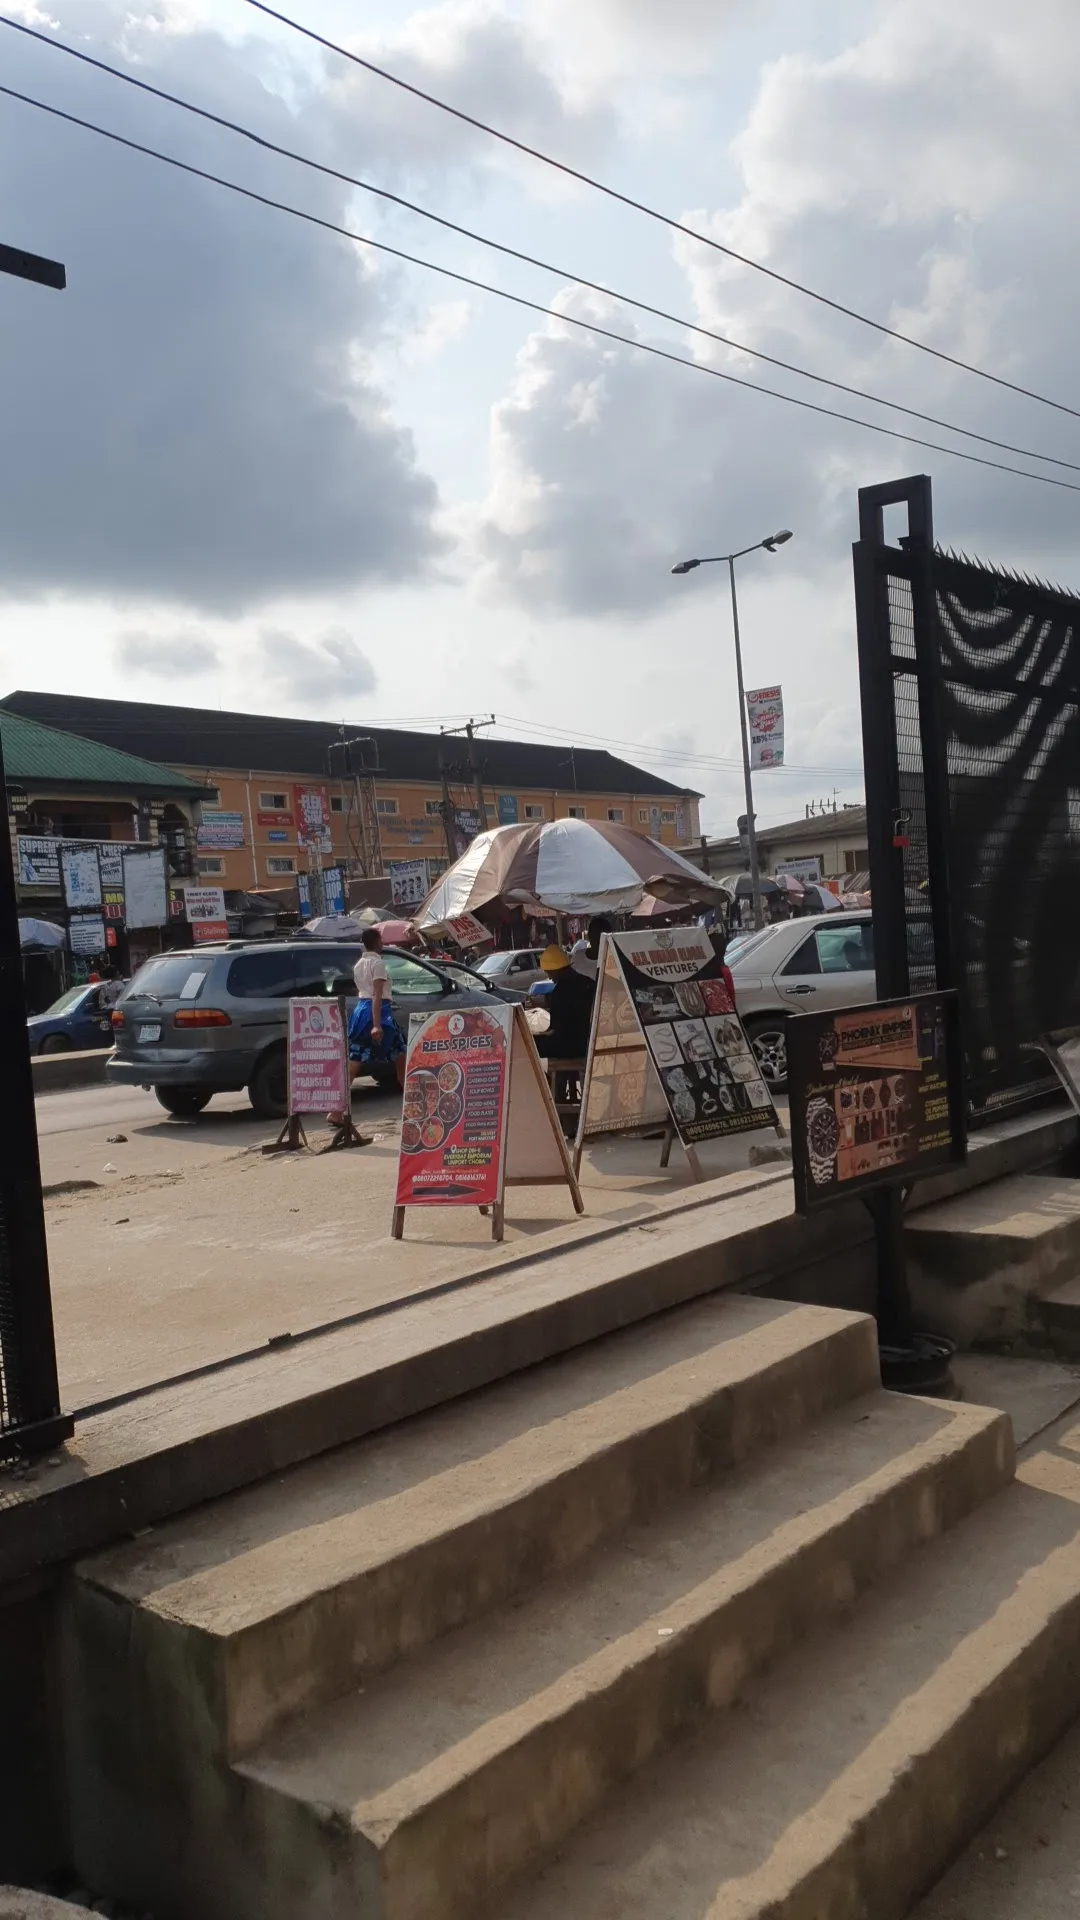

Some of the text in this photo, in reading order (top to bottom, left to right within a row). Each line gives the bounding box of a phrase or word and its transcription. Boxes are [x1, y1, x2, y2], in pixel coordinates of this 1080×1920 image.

[752, 734, 768, 744] 15%
[450, 915, 476, 933] POS
[456, 926, 483, 940] AVAILABLE
[467, 933, 483, 942] HERE
[646, 962, 699, 976] VENTURES
[841, 1024, 882, 1042] PHOENIX
[302, 1038, 334, 1049] CASHBACK
[421, 1035, 493, 1053] REES SPICES
[295, 1050, 341, 1061] WITHDRAWAL
[296, 1063, 324, 1074] DEPOSIT
[296, 1076, 332, 1088] TRANSFER
[296, 1090, 341, 1101] BUY AIRTIME
